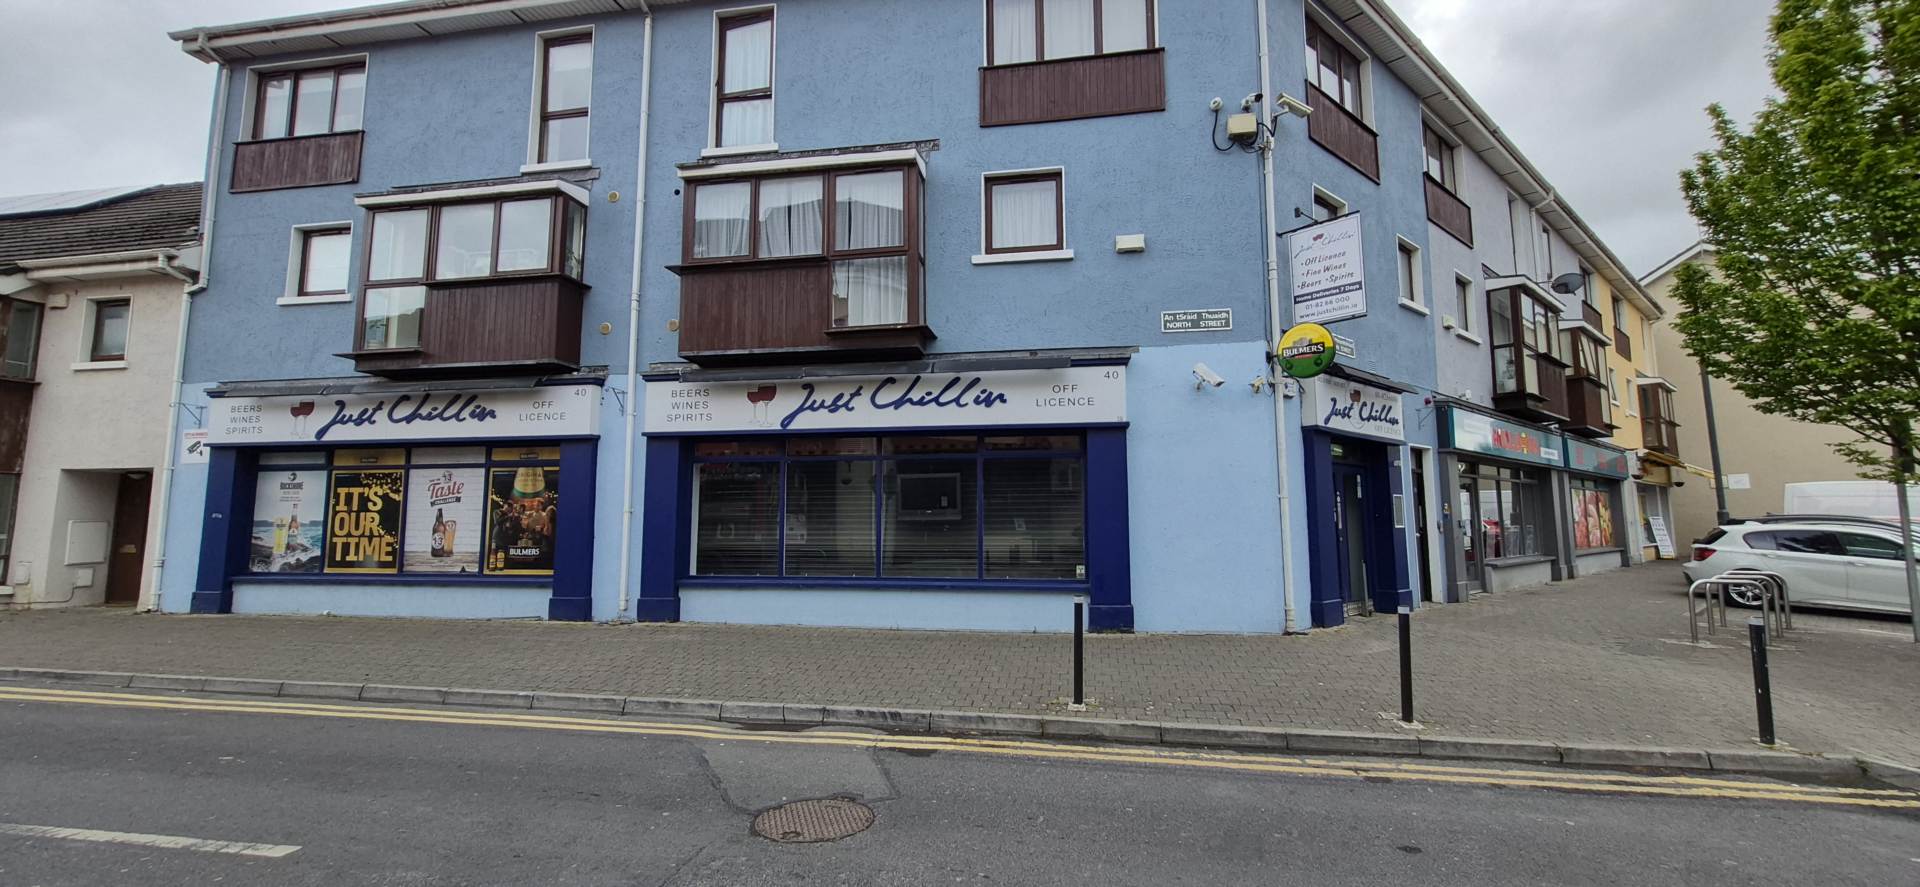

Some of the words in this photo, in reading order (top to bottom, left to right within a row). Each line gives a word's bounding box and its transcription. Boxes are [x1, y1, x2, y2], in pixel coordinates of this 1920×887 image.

[1305, 256, 1317, 266] Off
[1318, 251, 1347, 263] Licence
[1306, 269, 1321, 277] Fine
[1323, 262, 1347, 273] Wines
[1300, 279, 1322, 290] Beers
[1167, 321, 1192, 329] NORTH
[1200, 320, 1225, 328] STREET
[1283, 343, 1324, 357] BULMERS
[1104, 370, 1119, 380] 40
[574, 388, 587, 397] 40
[671, 388, 710, 398] BEERS
[1052, 384, 1079, 394] OFF
[532, 401, 554, 409] OFF
[671, 400, 709, 410] WINES
[780, 383, 863, 429] Just
[1035, 396, 1095, 408] LICENCE
[230, 404, 263, 413] BEERS
[1324, 397, 1354, 425] Just
[230, 415, 261, 424] WINES
[315, 400, 385, 440] Just
[519, 412, 567, 422] LICENCE
[666, 412, 713, 423] SPIRITS
[225, 426, 263, 435] SPIRITS
[428, 480, 464, 499] Taste
[336, 485, 383, 511] IT'S
[334, 512, 380, 536] OUR
[332, 537, 394, 561] TIME
[509, 547, 540, 556] BULMERS
